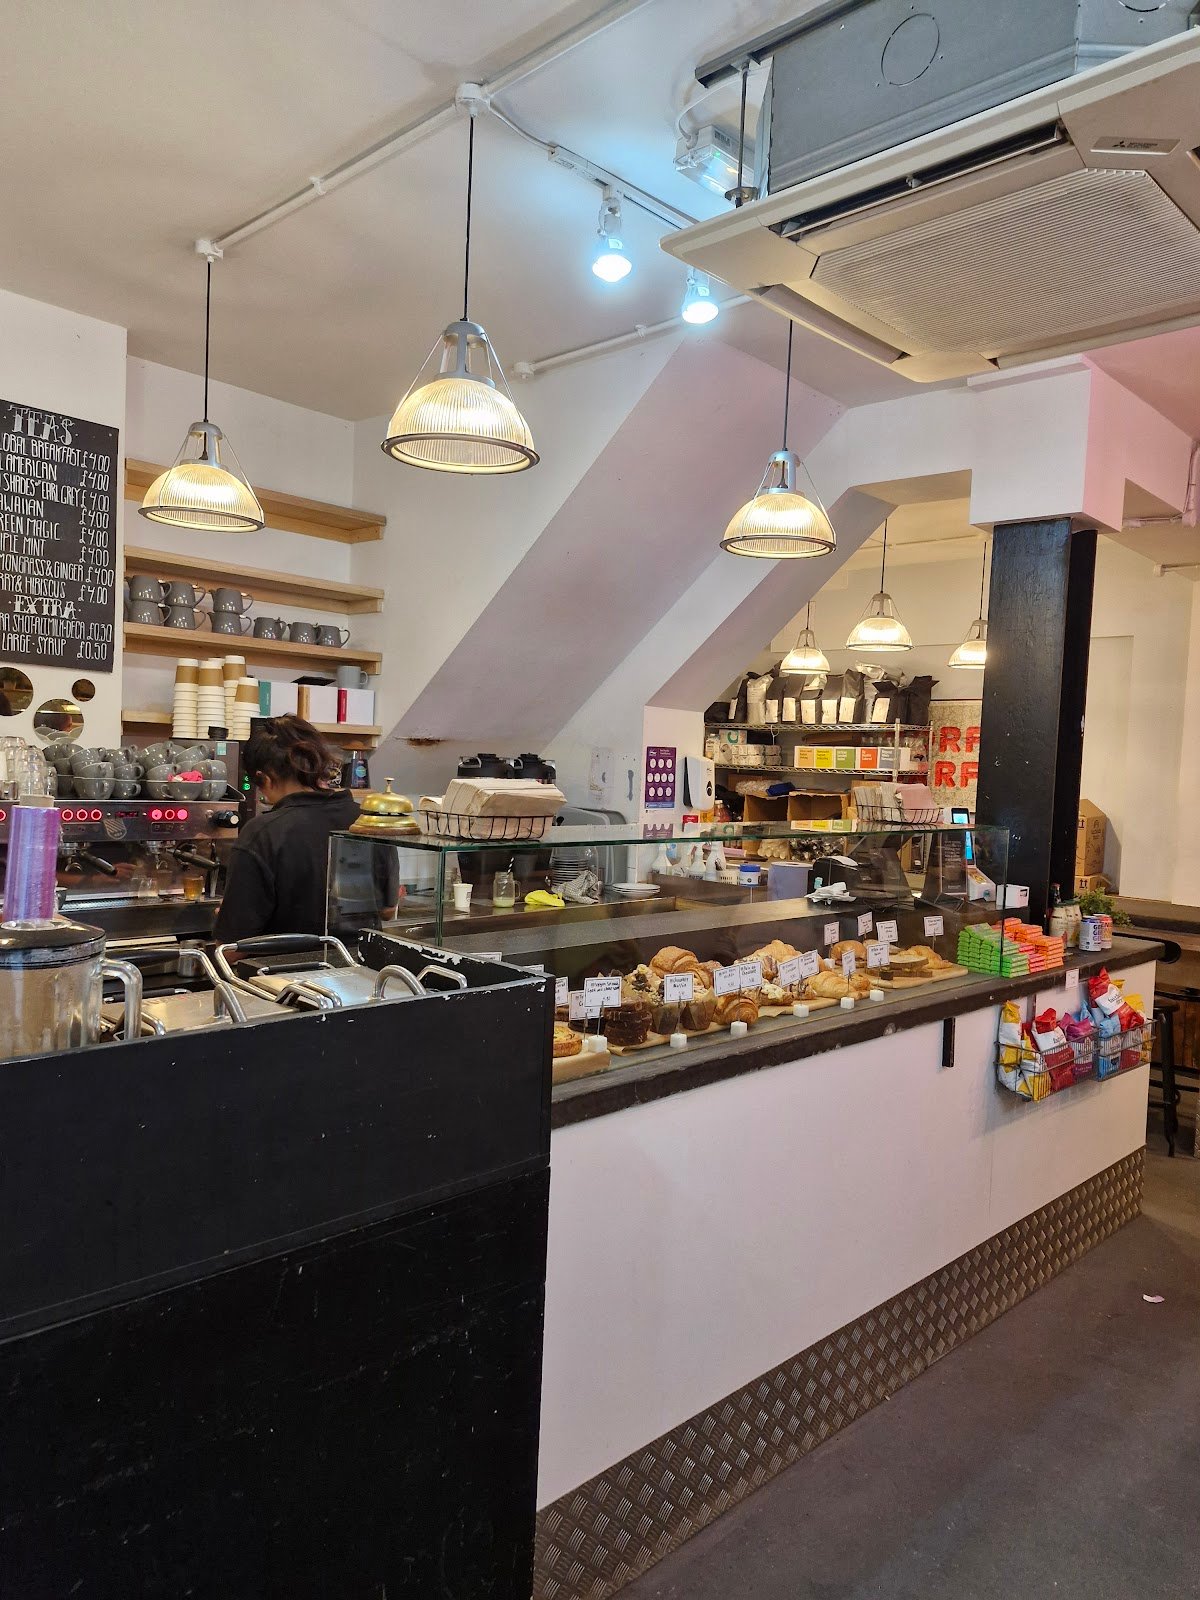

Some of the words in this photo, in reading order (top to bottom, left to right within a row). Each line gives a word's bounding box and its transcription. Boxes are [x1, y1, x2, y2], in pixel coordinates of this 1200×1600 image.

[8, 405, 75, 445] TEAS
[0, 433, 28, 456] OBAL
[31, 439, 82, 467] BREAKFAST
[81, 451, 110, 473] £4.00
[6, 454, 57, 481] AMERICAN
[80, 470, 109, 491] £4.00
[3, 473, 35, 497] SHADES
[42, 481, 60, 502] EARL
[61, 485, 82, 507] GREY
[81, 490, 109, 512] £4.00
[26, 518, 60, 540] MAGIC
[79, 527, 109, 548] £4.00
[79, 508, 109, 529] £4.00
[22, 537, 46, 556] MINT
[79, 546, 109, 567] £4.00
[25, 577, 66, 599] HIBISCUS
[78, 585, 108, 605] £4.00
[86, 567, 115, 587] £4.00
[14, 595, 77, 620] EXTRA
[2, 632, 31, 653] LARGE
[36, 636, 67, 656] SYRUP
[77, 641, 107, 660] £0.50
[86, 622, 112, 643] £0.30
